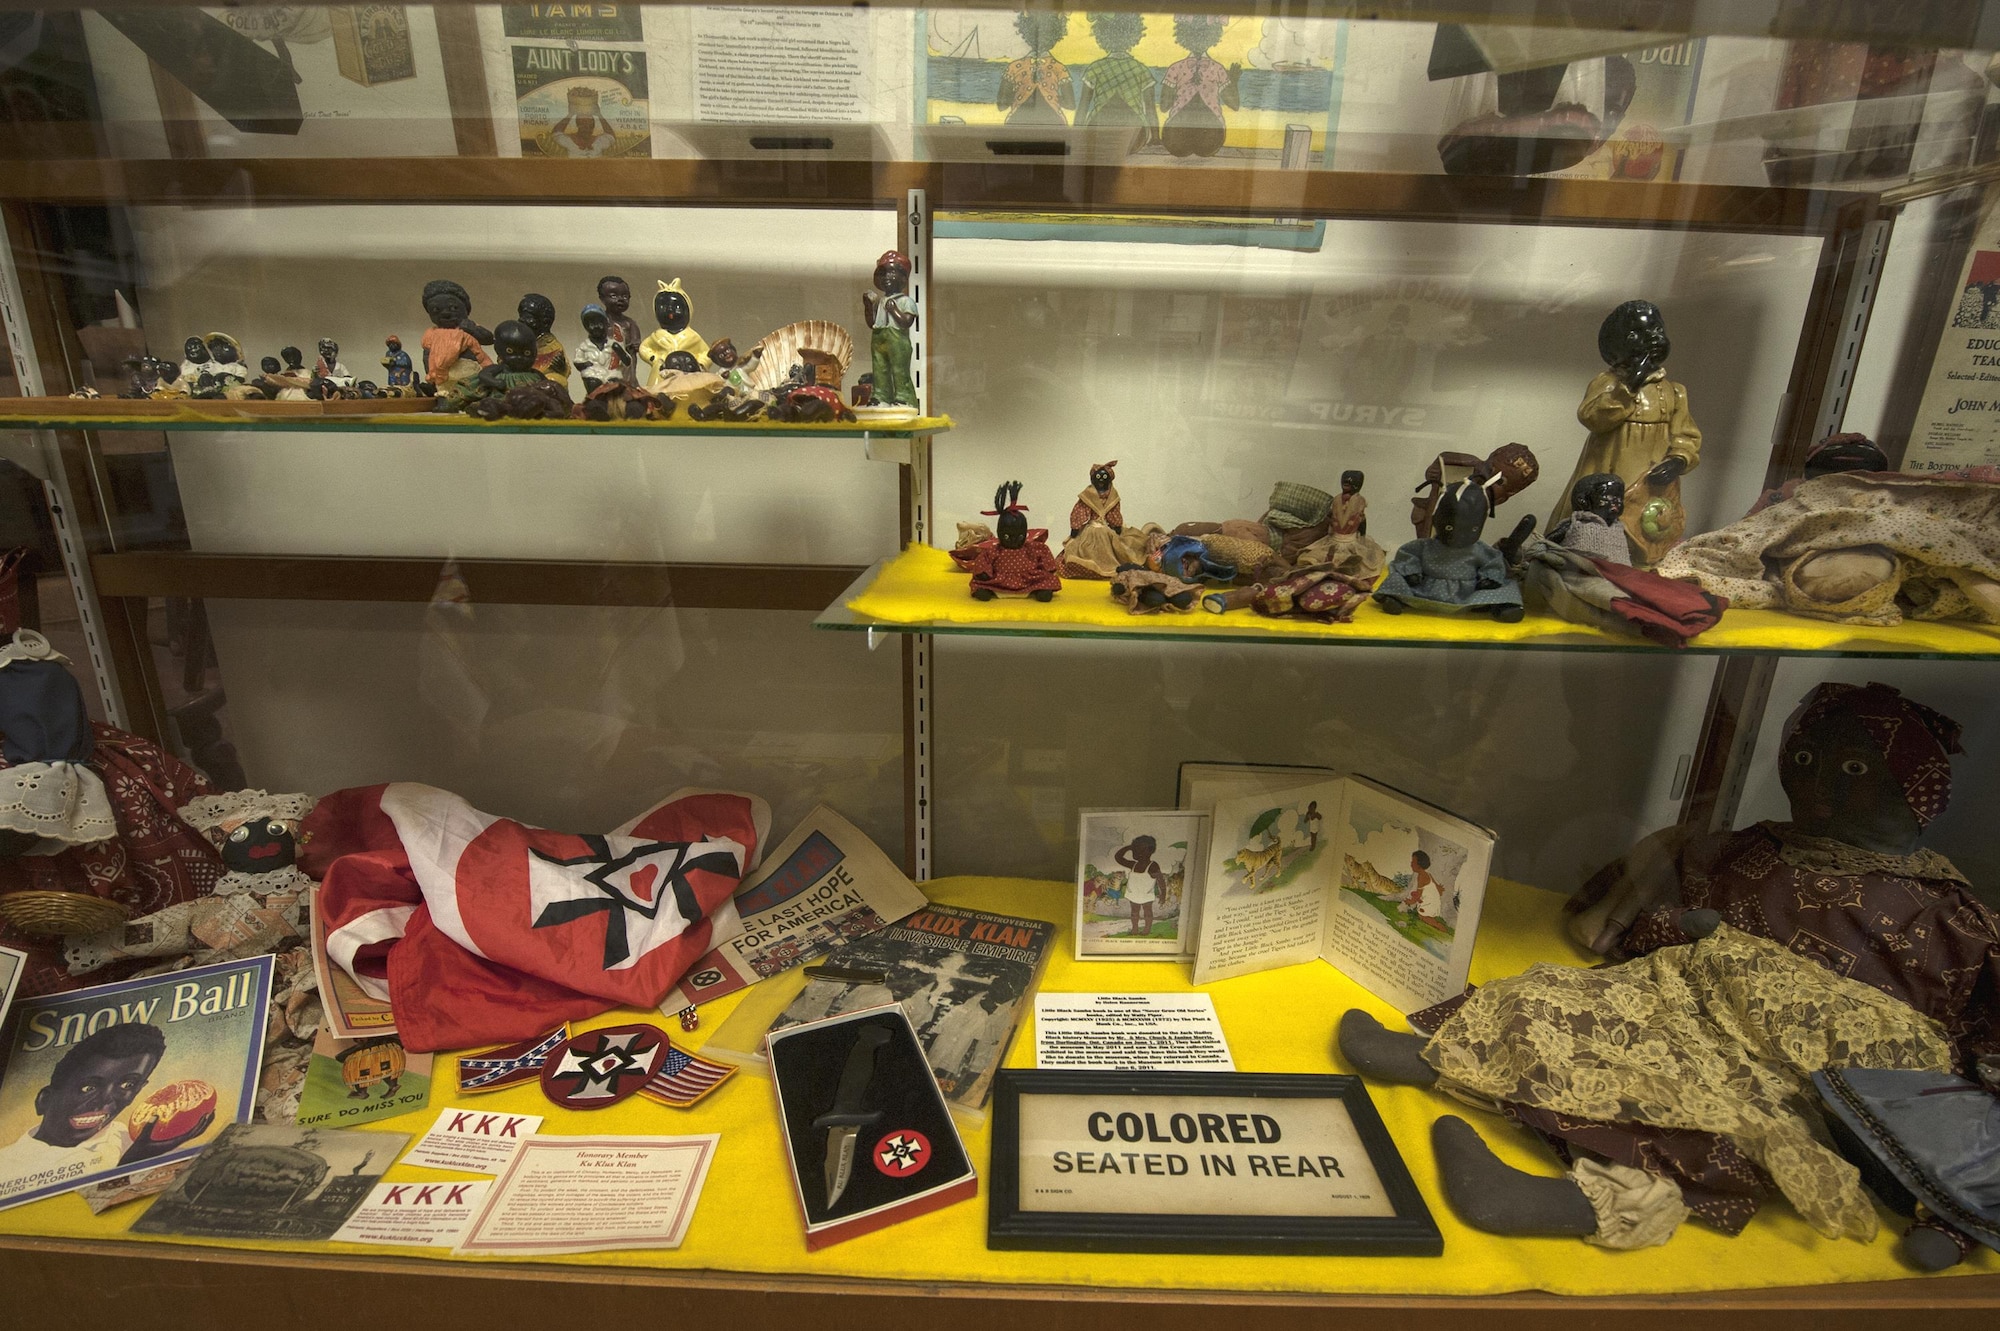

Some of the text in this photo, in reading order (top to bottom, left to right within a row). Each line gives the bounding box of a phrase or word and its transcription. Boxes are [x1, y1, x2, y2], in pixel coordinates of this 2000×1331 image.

[527, 48, 572, 71] AUNT
[1948, 399, 1988, 414] JOHN
[1910, 460, 1924, 470] THE
[1927, 462, 1960, 471] BOSTON
[758, 903, 807, 926] LAST
[806, 865, 854, 907] HOPE
[731, 929, 774, 954] FOR
[777, 889, 865, 934] AMERICA!
[906, 912, 1034, 948] KLUX KLAN
[929, 905, 1042, 930] BEHIND THE CONTROVERSIAL
[889, 928, 970, 953] INVISIBLE
[971, 942, 1038, 965] EMPIRE
[22, 970, 252, 1053] Snow Ball
[208, 1010, 247, 1024] BRAND
[298, 1093, 424, 1126] SURE DO MISS YOU
[1087, 1111, 1282, 1144] COLORED
[425, 1158, 488, 1170] www.kukluxklan.org
[576, 1152, 614, 1160] Honorary
[1053, 1150, 1345, 1178] SEATED IN REAR
[0, 1170, 54, 1190] HERLONG
[68, 1162, 86, 1171] CO.
[37, 1169, 84, 1186] FLORIDA
[359, 1234, 433, 1243] www.kukluxklan.org
